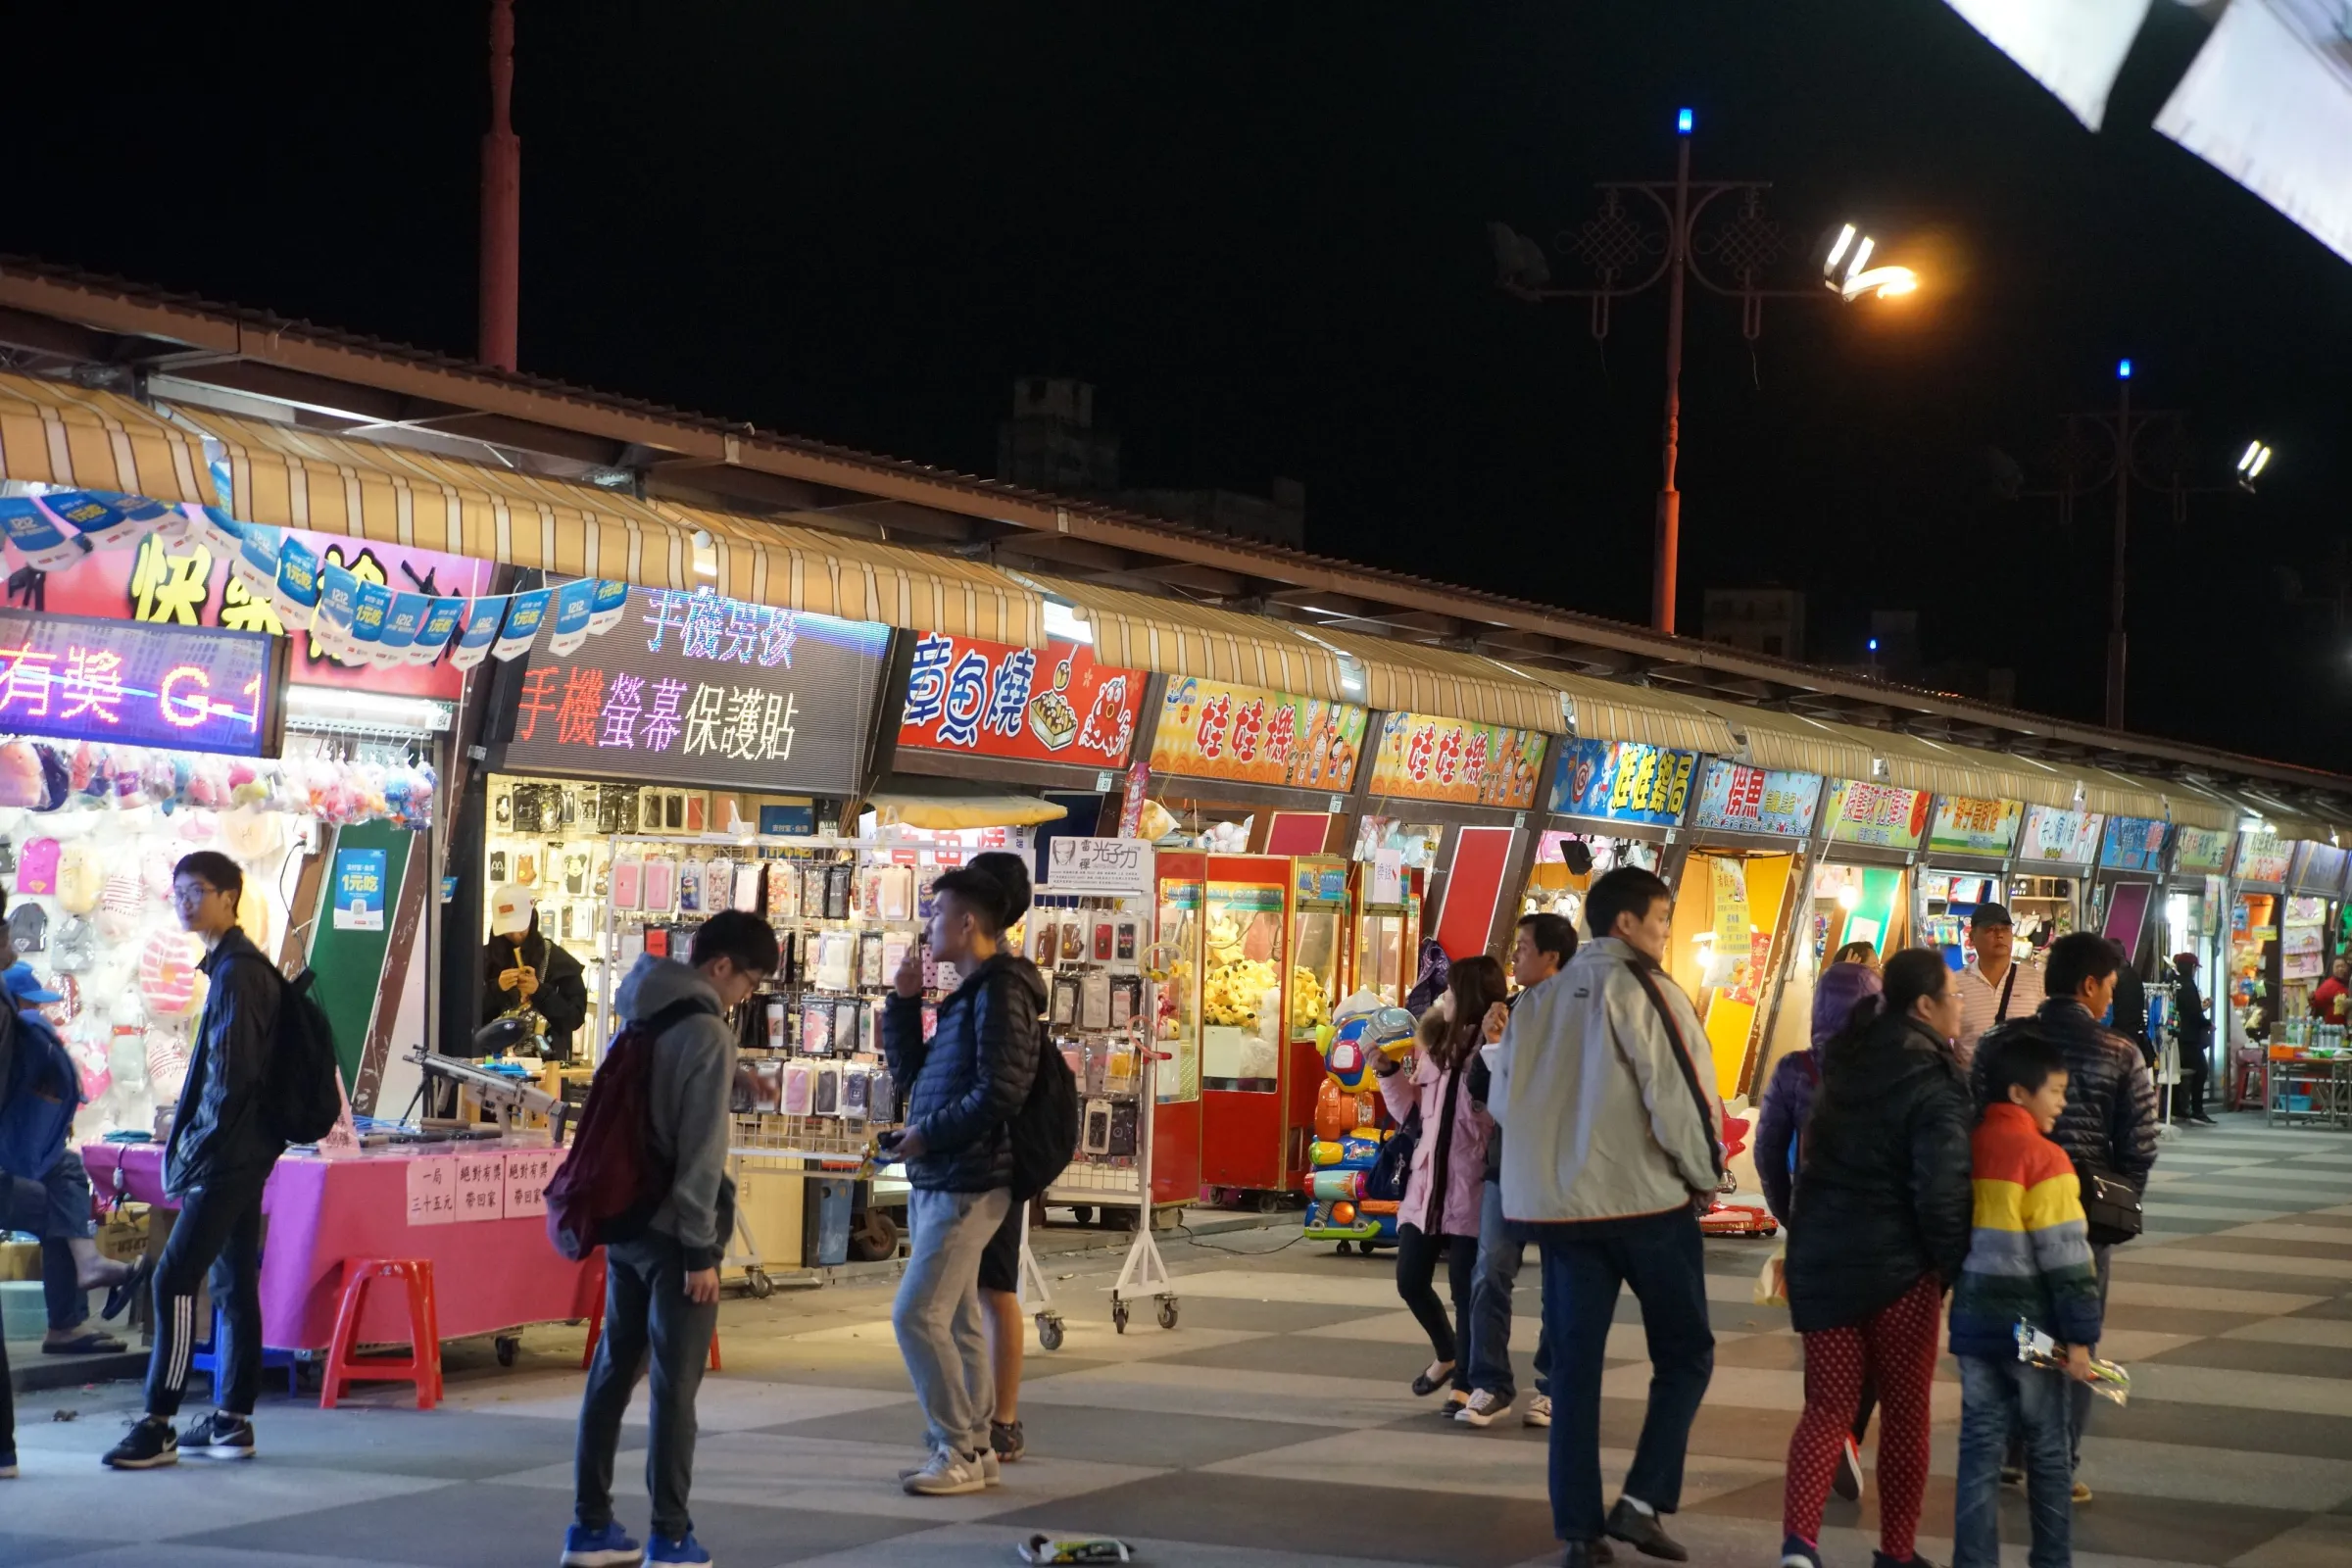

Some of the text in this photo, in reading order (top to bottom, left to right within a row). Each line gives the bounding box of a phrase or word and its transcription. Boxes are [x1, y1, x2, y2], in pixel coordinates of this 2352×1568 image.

[332, 587, 350, 605] 1212
[567, 600, 585, 612] 1212
[396, 613, 414, 626] 1212
[642, 585, 799, 669] 手機男孩
[0, 641, 122, 724] 有獎
[904, 631, 1037, 748] 章魚燒
[518, 665, 800, 761] 手機螢幕保護貼
[1196, 691, 1298, 766] 娃娃機
[1406, 721, 1490, 788] 娃娃機
[1092, 840, 1138, 869] 光子力
[341, 874, 379, 893] 1元吃
[422, 1167, 443, 1185] 一局
[460, 1163, 502, 1183] 絕對有獎
[509, 1160, 549, 1180] 絕對有獎
[412, 1195, 454, 1213] 三十五元
[466, 1189, 497, 1209] 帶回家
[514, 1187, 542, 1205] 帶回家
